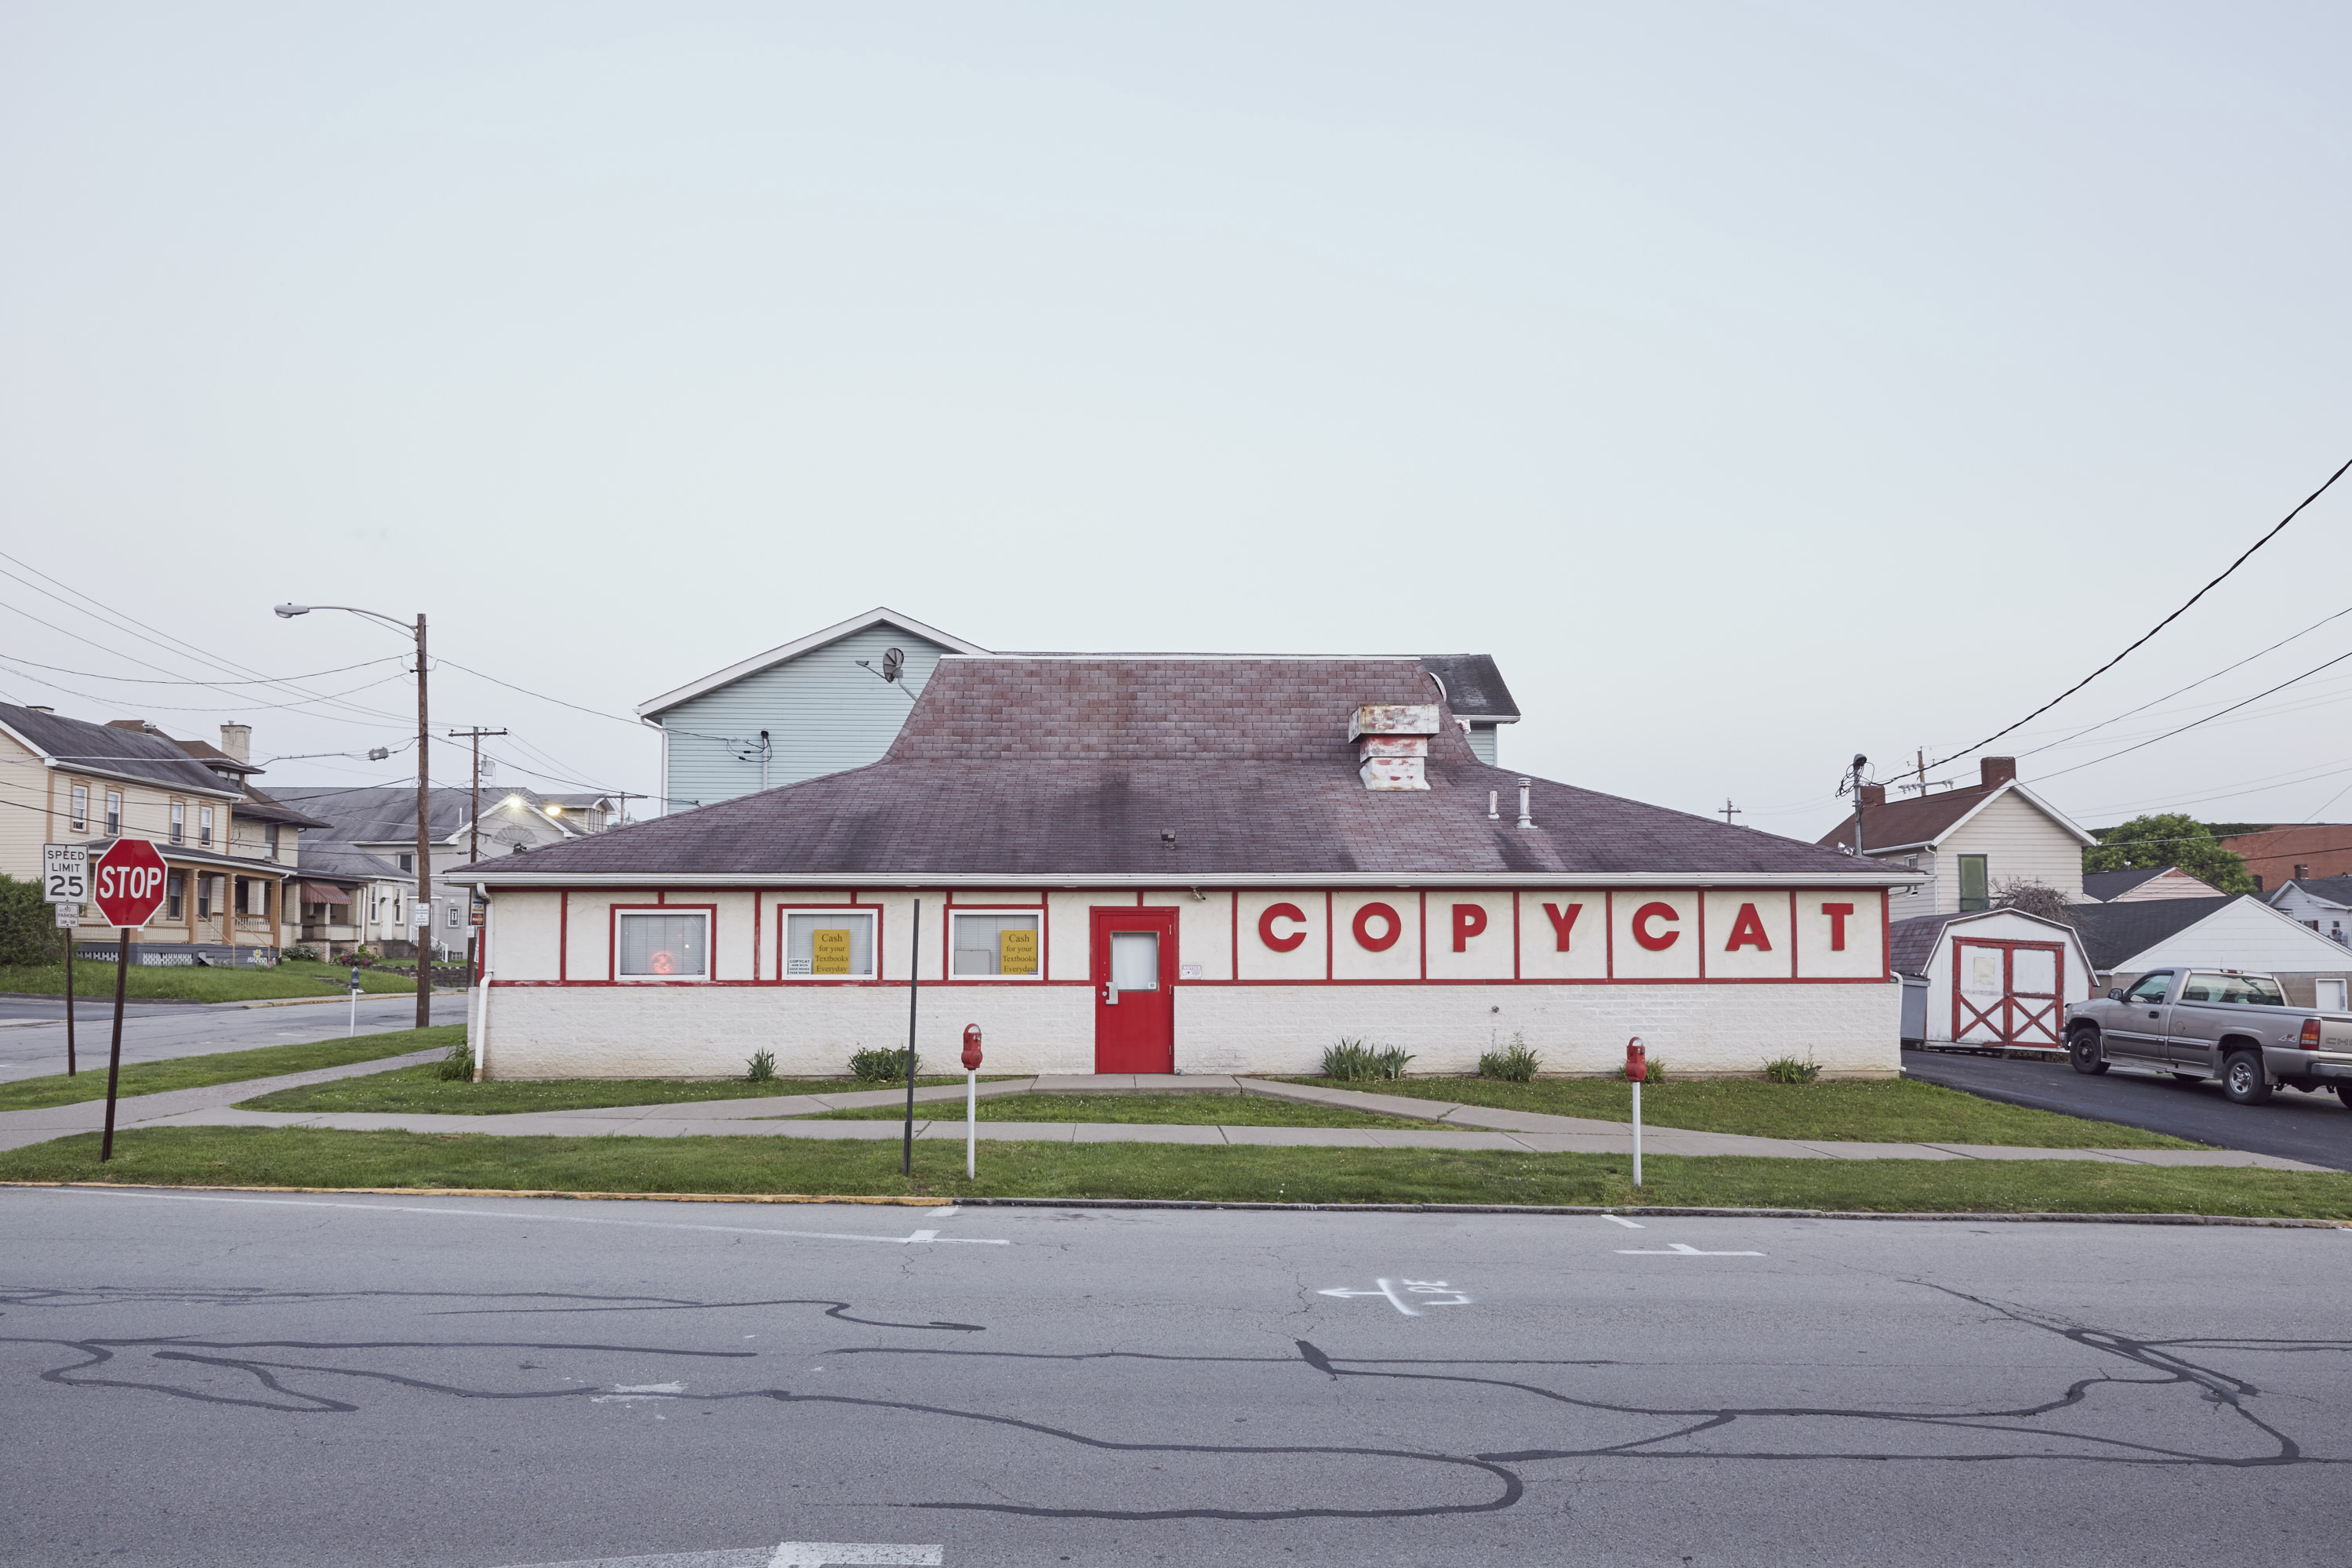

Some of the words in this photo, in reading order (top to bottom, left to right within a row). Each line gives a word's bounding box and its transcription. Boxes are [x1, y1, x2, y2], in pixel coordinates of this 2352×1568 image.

[47, 850, 85, 860] SPEED
[52, 862, 81, 872] LIMIT
[49, 875, 84, 897] 25
[100, 866, 162, 898] STOP
[1258, 902, 1854, 953] COPYCAT
[822, 934, 843, 942] Cash
[1008, 934, 1029, 942] Cash
[816, 965, 848, 974] Everyday
